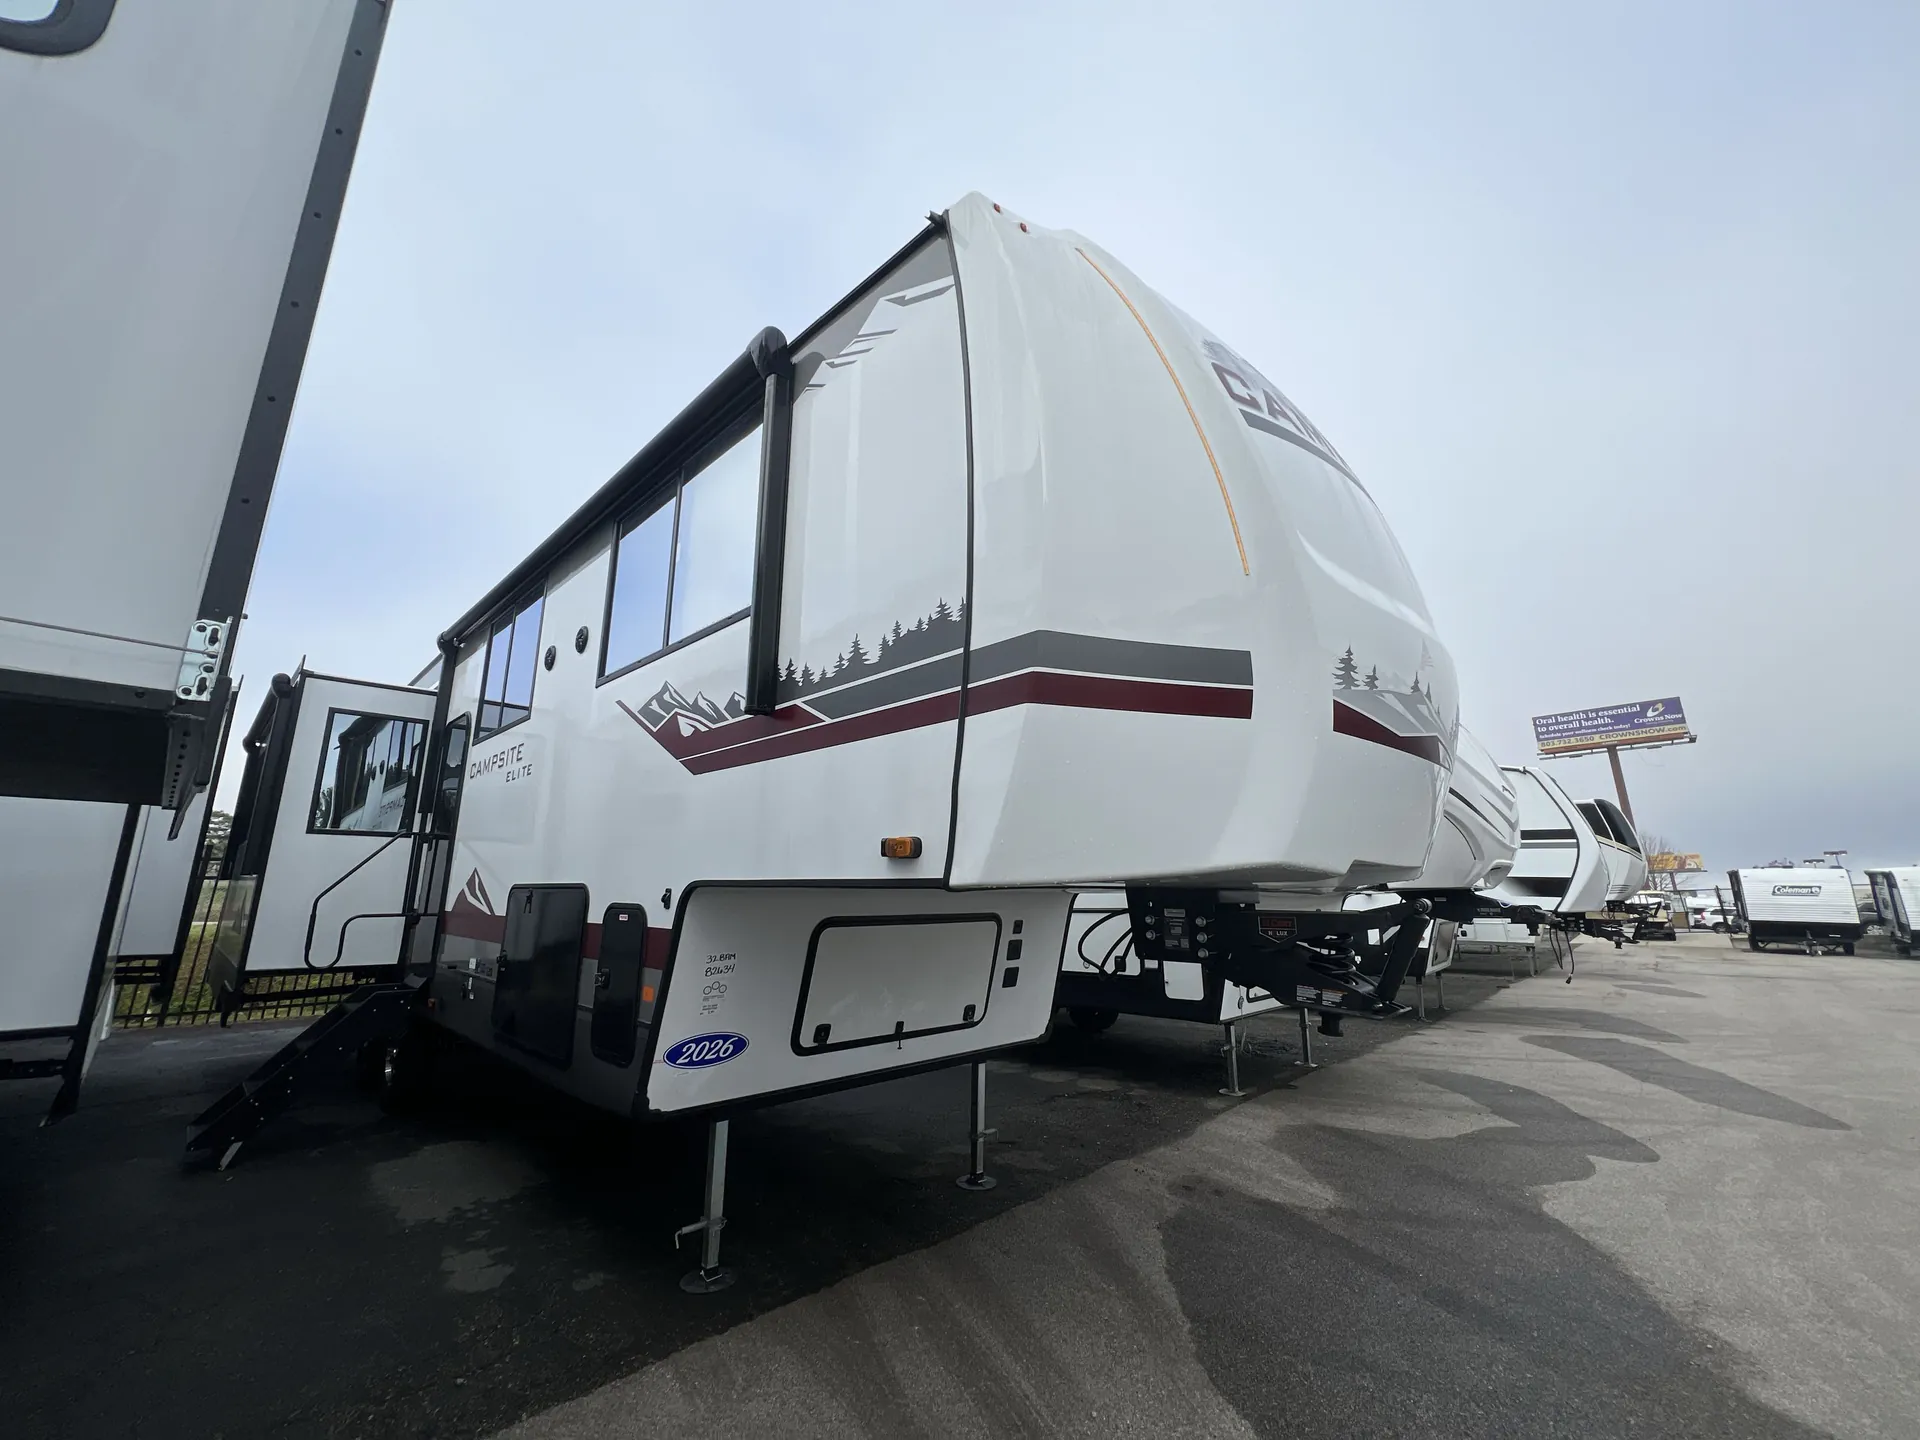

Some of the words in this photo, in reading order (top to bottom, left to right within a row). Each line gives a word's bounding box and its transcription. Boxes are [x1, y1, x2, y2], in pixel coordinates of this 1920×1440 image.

[1536, 716, 1556, 725] Oral
[1557, 712, 1586, 722] health
[1598, 704, 1640, 717] essential
[1548, 721, 1580, 731] overall
[1582, 717, 1614, 727] health.
[1634, 716, 1664, 724] Crowns
[1541, 736, 1595, 747] 803.732.3650
[1599, 726, 1687, 740] CROWNSNOW.com
[470, 742, 525, 780] CAMPSITE
[505, 763, 533, 783] ELITE
[1774, 885, 1811, 894] Coleman
[675, 1037, 739, 1065] 2026
